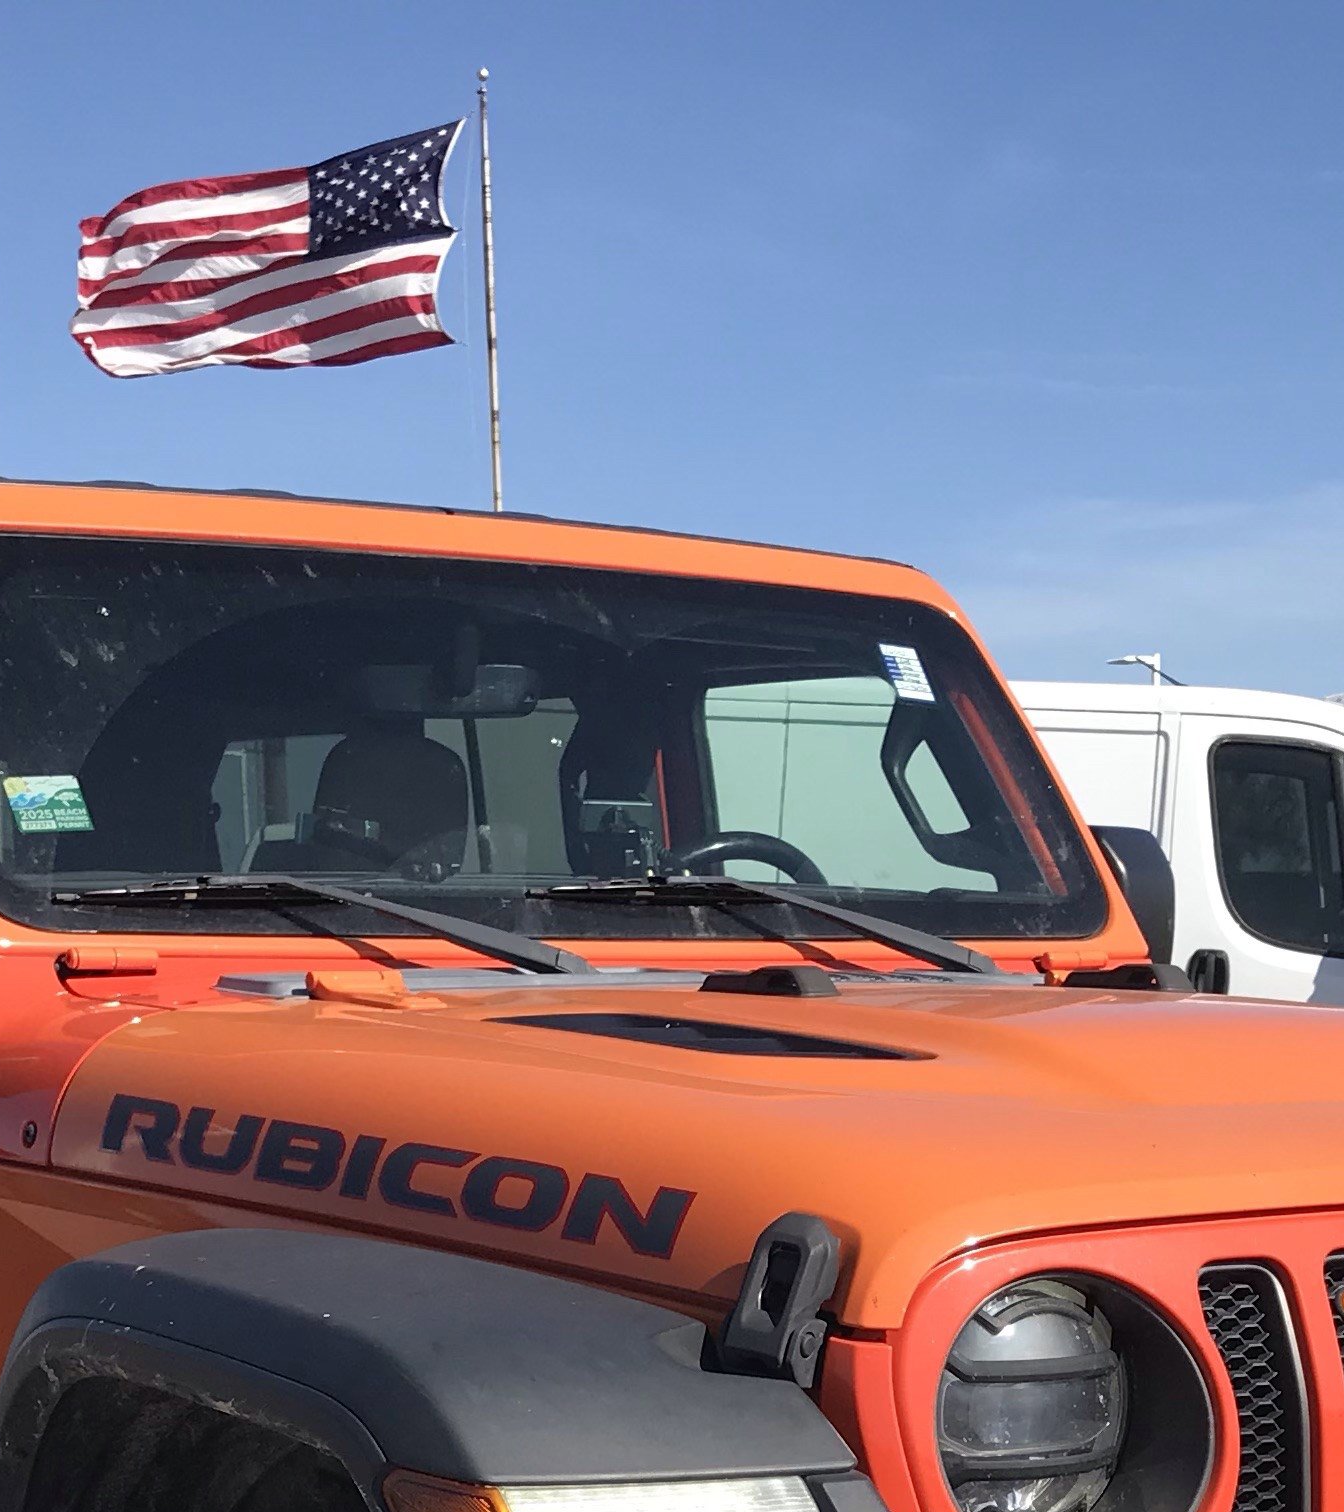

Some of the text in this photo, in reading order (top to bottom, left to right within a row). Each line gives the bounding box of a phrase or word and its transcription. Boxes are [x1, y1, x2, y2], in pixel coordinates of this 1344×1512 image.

[19, 808, 86, 820] 2025 BEACH
[101, 1092, 697, 1260] RUBICON
